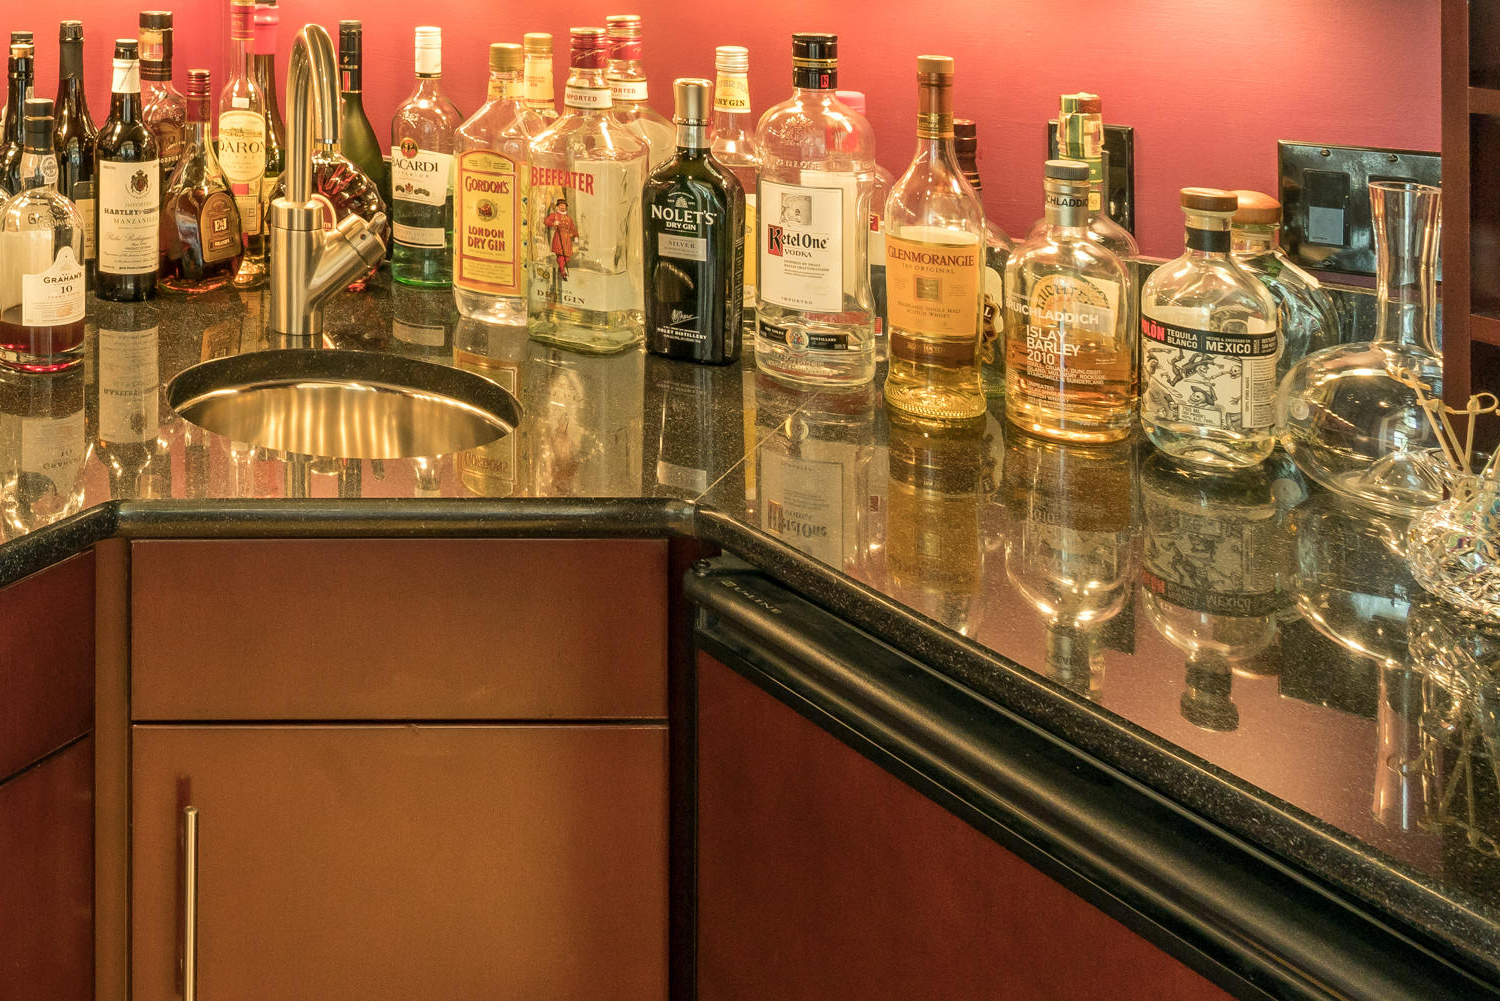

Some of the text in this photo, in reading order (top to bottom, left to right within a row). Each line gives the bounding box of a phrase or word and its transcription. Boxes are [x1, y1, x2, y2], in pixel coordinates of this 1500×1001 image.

[531, 165, 594, 195] BEEFEATER
[651, 203, 715, 226] NOLET'S
[468, 225, 504, 239] LONDON
[666, 221, 697, 231] DRY GIN
[467, 236, 505, 251] DRY GIN
[769, 226, 827, 252] Ketel One
[784, 249, 813, 258] VODKA
[888, 245, 975, 267] GLENMORANGIE
[914, 264, 956, 274] ORIGINAL
[61, 284, 73, 294] 10
[563, 294, 585, 305] GIN
[1026, 325, 1067, 342] ISLAY
[1166, 328, 1198, 341] TEQUILA
[1026, 337, 1081, 356] BARLEY
[1167, 337, 1198, 349] BLANCO
[1205, 341, 1252, 354] MEXICO
[1026, 349, 1055, 365] 2010
